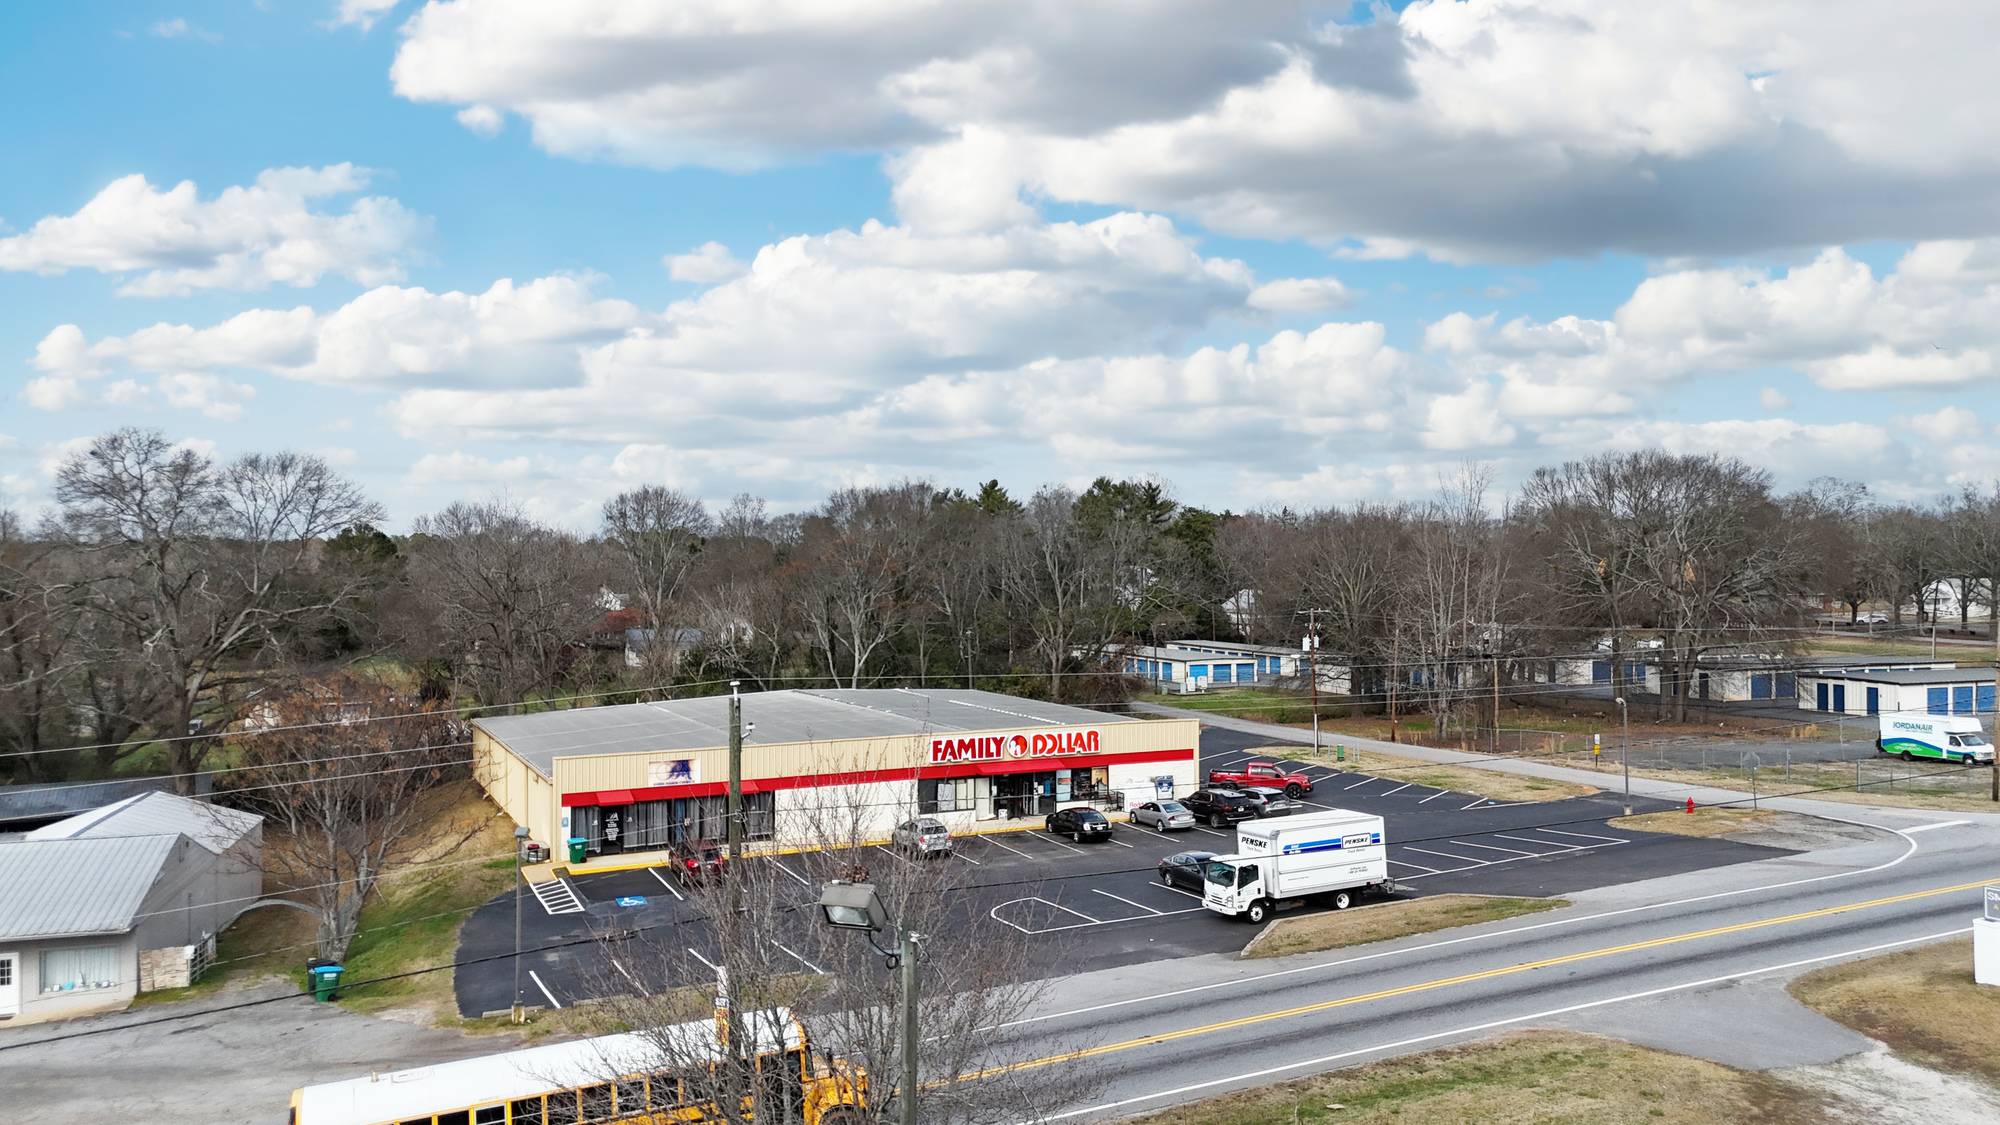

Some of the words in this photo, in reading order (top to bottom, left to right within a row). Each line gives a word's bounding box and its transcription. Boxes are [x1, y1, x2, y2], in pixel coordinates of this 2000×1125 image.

[932, 736, 1006, 762] FAMILY
[1032, 730, 1099, 755] DOLLAR
[1241, 836, 1268, 849] PENSKE
[1344, 837, 1369, 846] PENSKE
